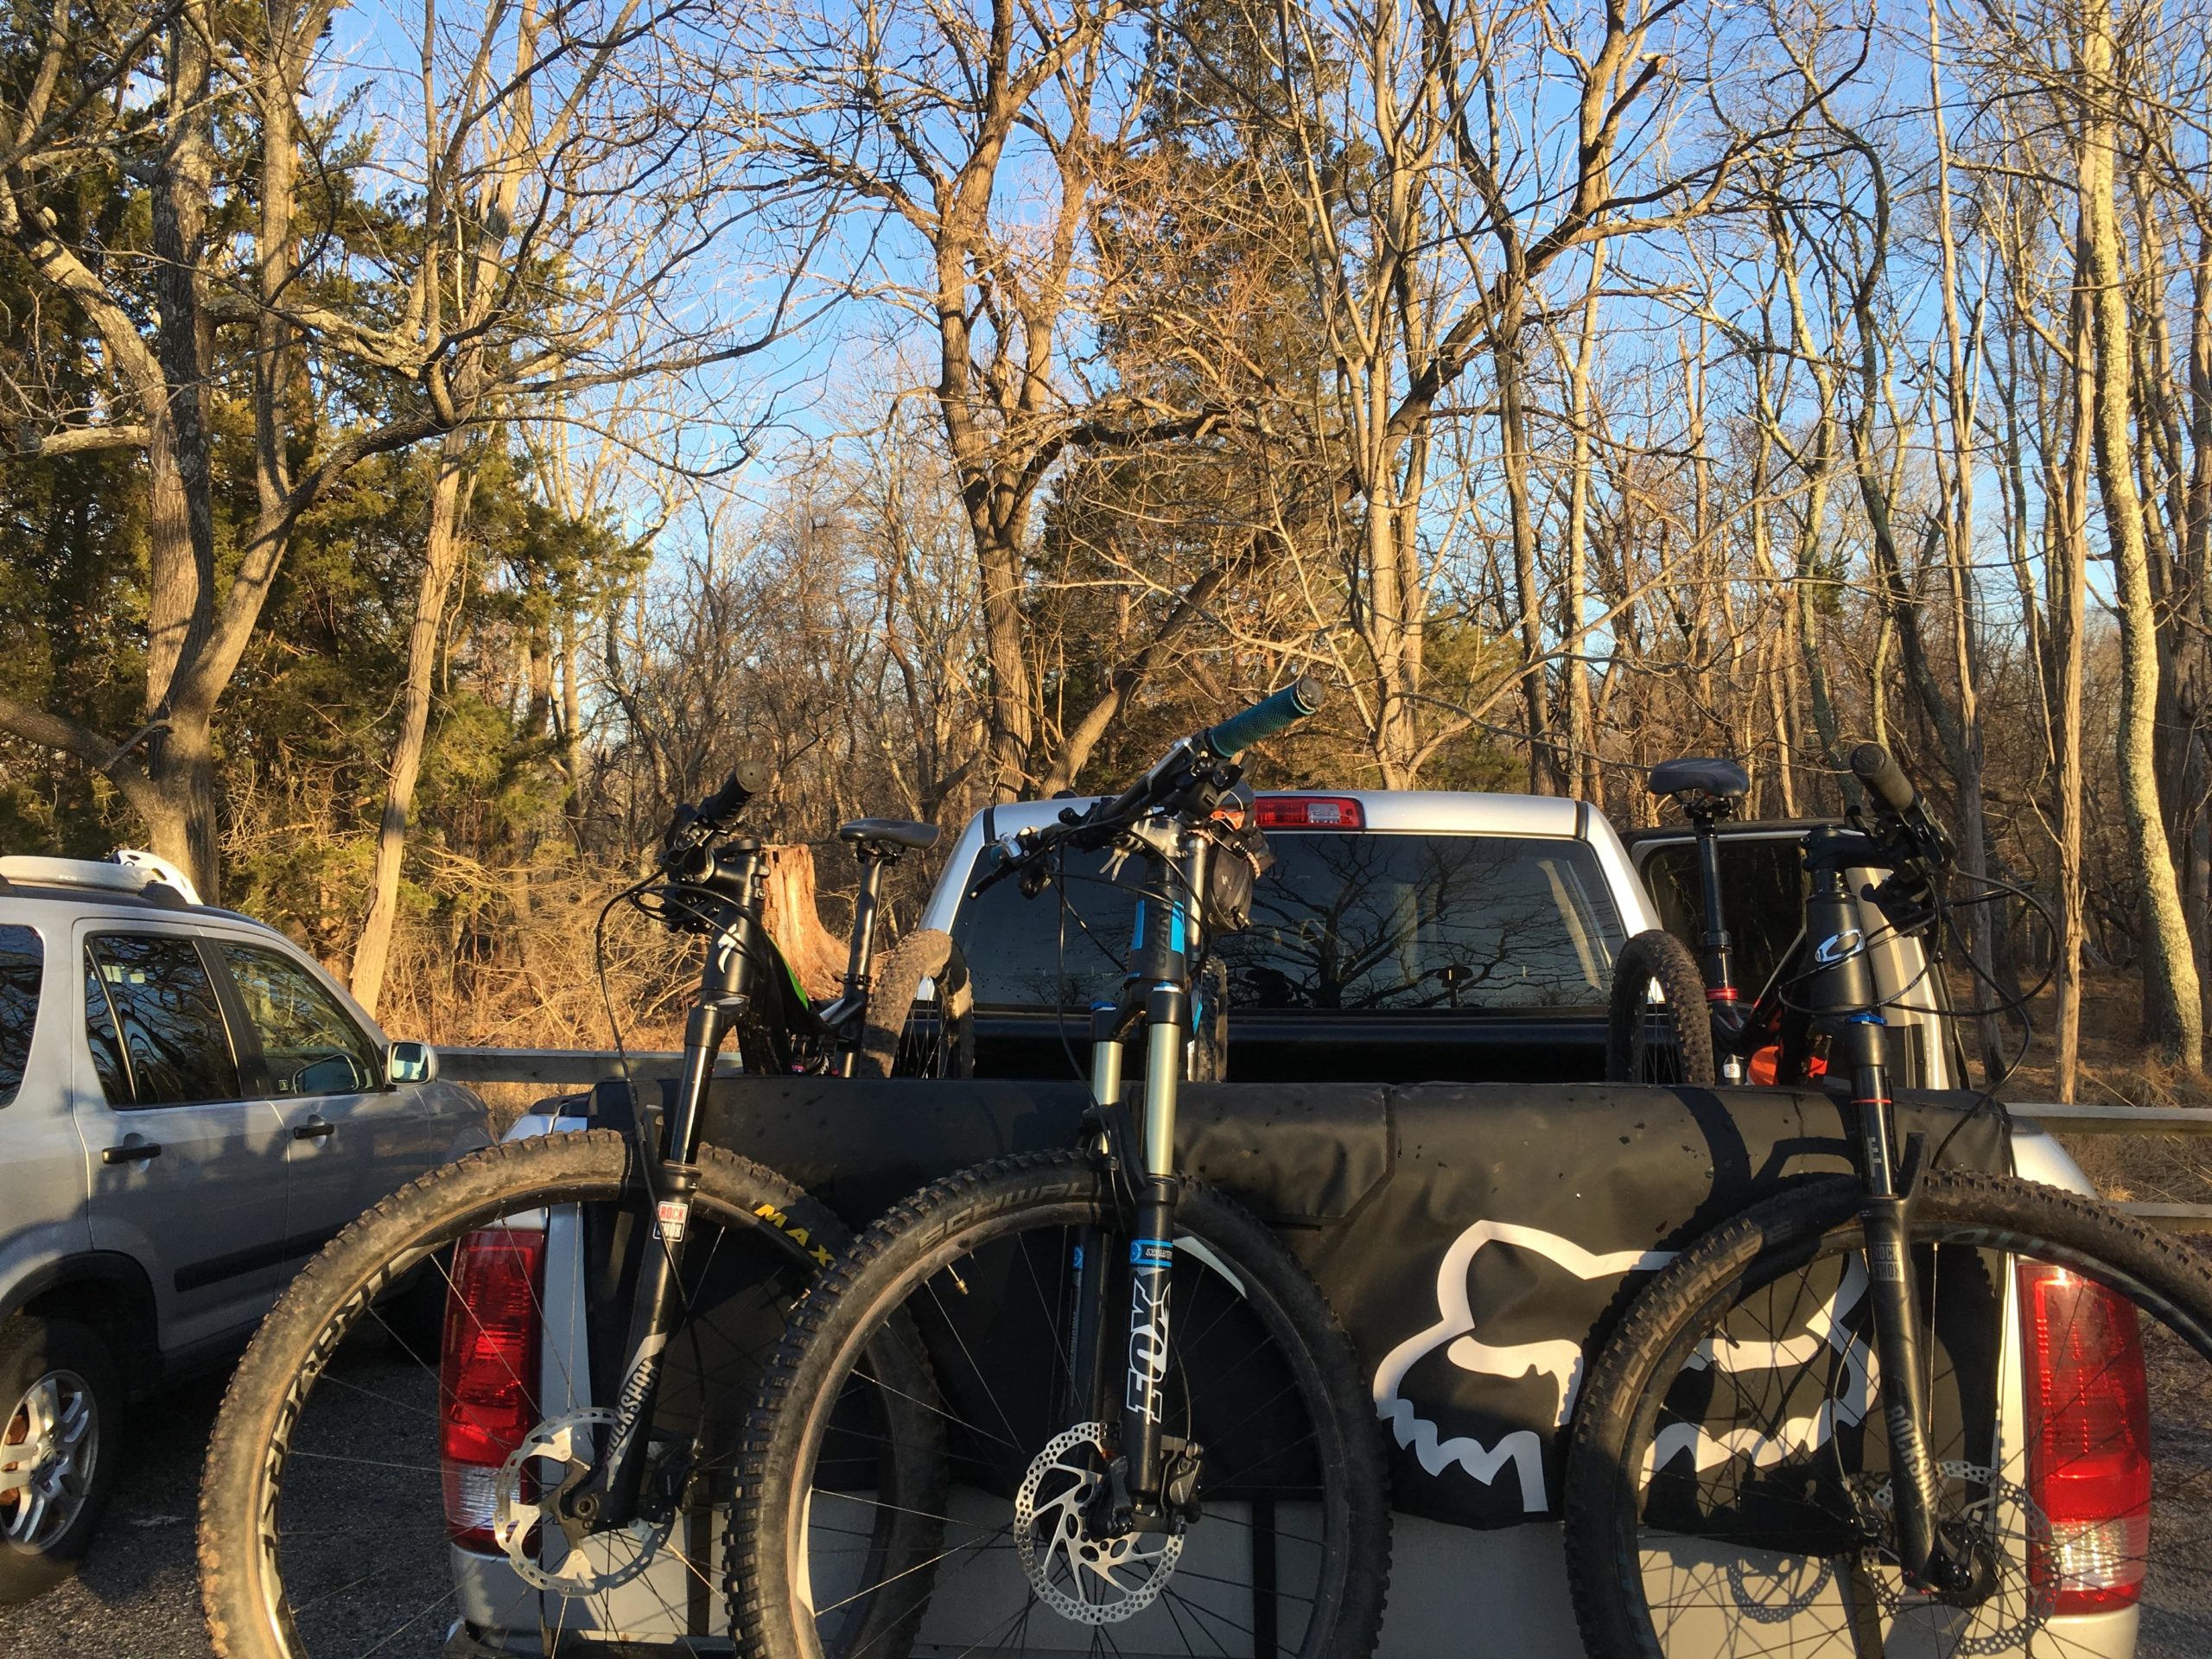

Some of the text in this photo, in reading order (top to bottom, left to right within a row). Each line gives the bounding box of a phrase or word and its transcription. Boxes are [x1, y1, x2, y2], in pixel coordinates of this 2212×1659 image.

[660, 1206, 684, 1221] ROCK
[1872, 1245, 1899, 1260] ROCK
[1127, 1276, 1171, 1424] FOX
[607, 1359, 660, 1458] ROCKSHOX
